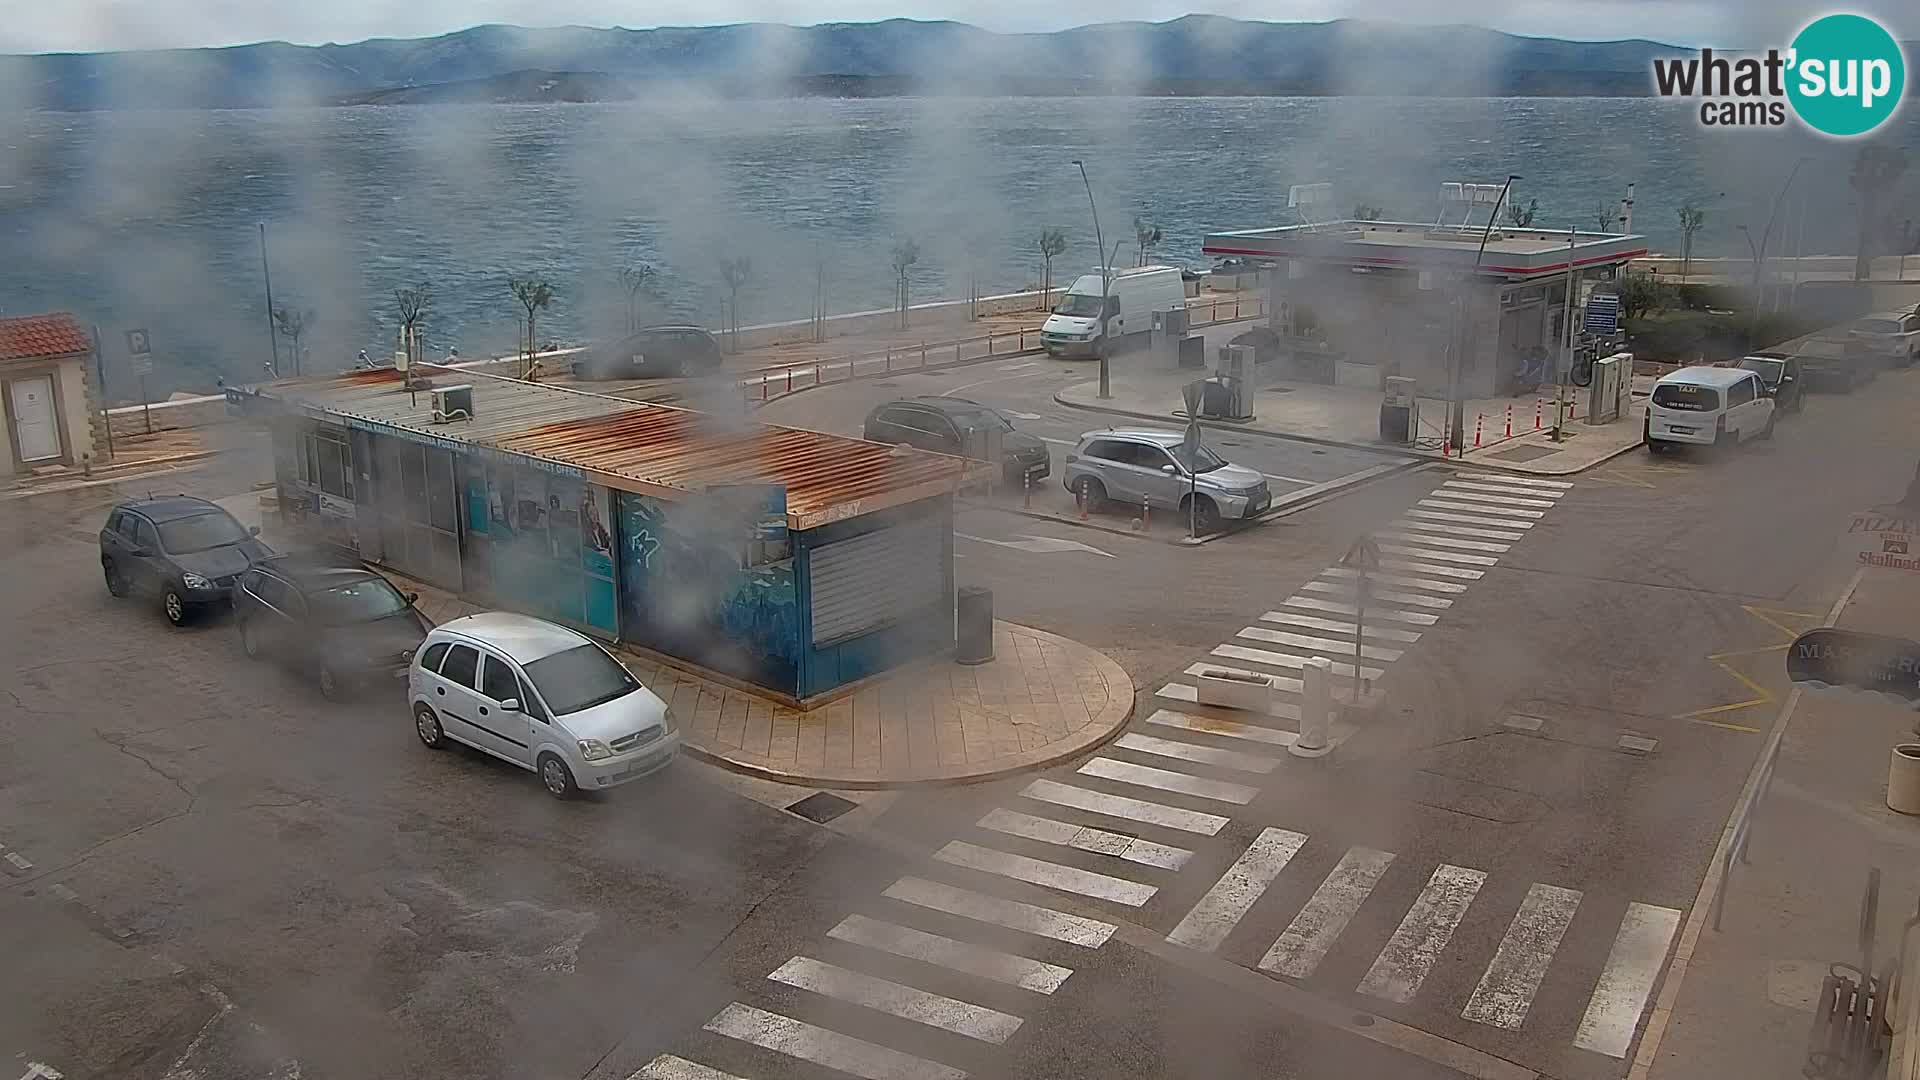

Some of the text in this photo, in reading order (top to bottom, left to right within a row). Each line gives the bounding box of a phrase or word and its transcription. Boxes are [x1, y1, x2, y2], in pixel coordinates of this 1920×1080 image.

[1679, 385, 1697, 394] TAXI
[529, 459, 555, 473] TICKET
[556, 465, 583, 477] OFFICE
